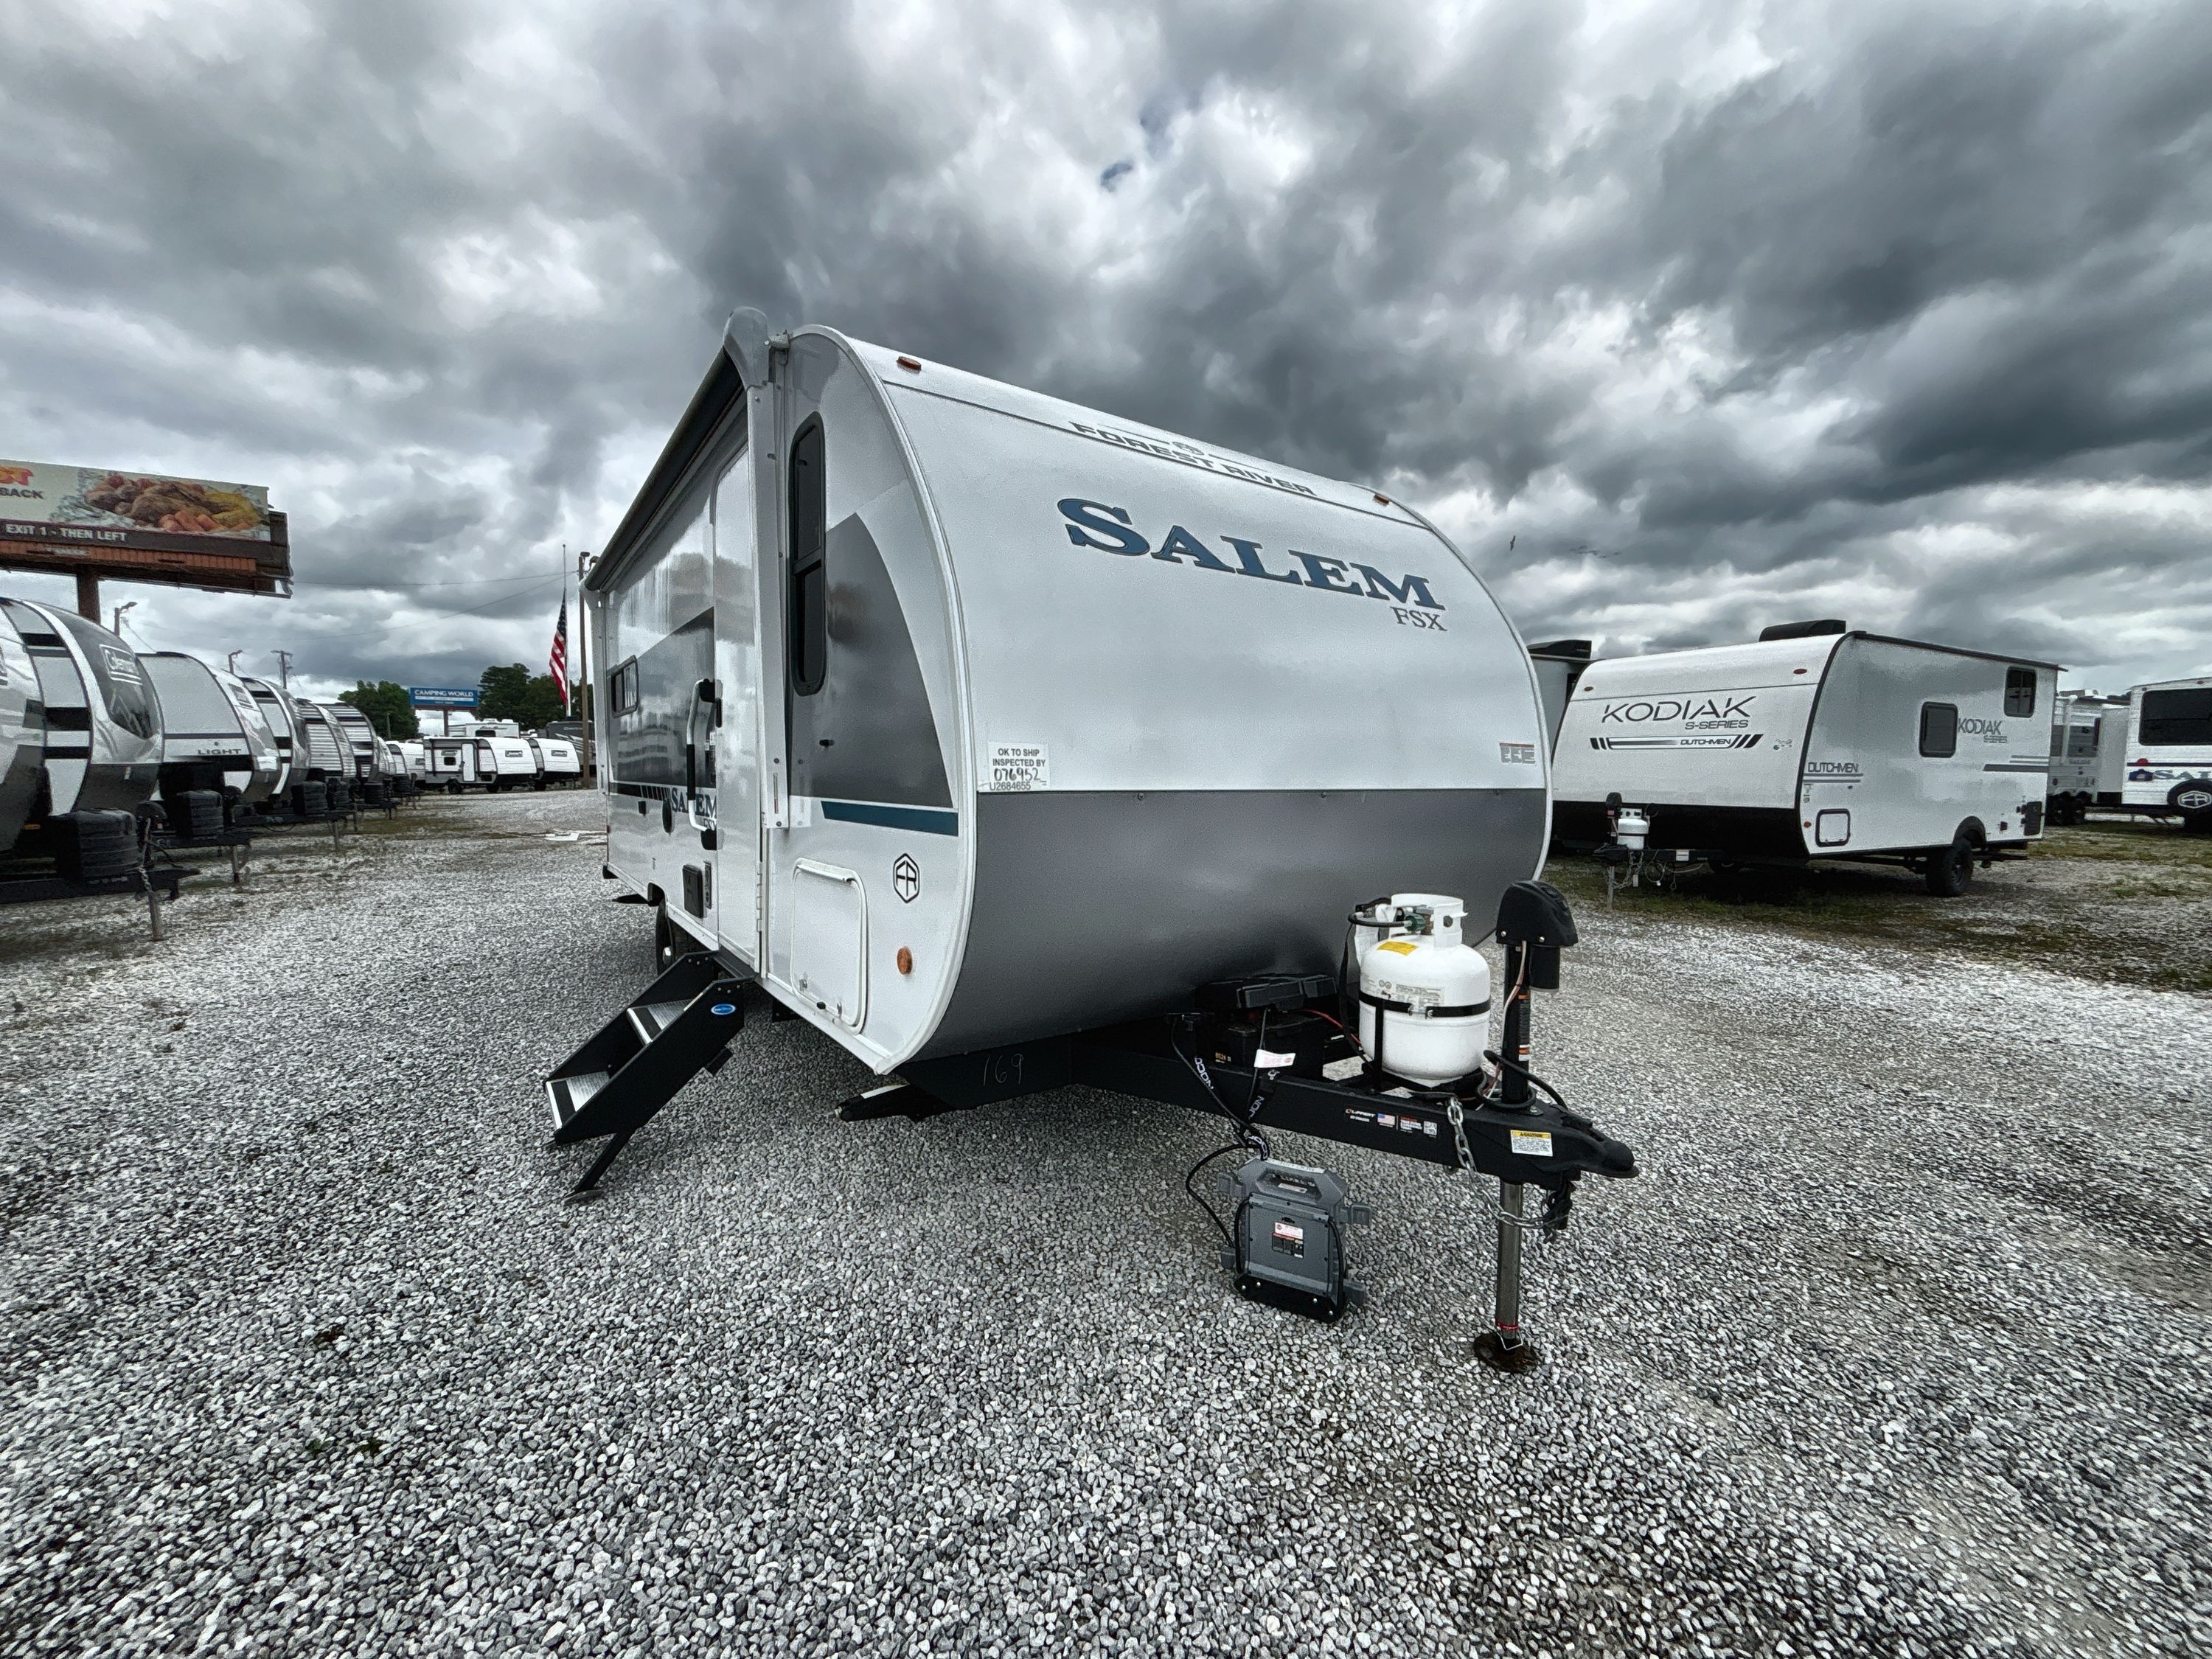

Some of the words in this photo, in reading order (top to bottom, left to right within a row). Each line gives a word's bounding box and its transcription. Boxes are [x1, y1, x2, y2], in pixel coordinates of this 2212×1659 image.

[1068, 421, 1214, 468] FOREST
[1222, 464, 1317, 496] RIVER
[6, 524, 35, 535] EXIT
[40, 527, 46, 535] 1
[60, 527, 93, 539] THEN
[97, 530, 127, 541] LEFT
[1057, 498, 1446, 611] SALEM
[1391, 606, 1447, 631] FSX
[1601, 695, 1757, 723] KODIAK
[1685, 719, 1749, 730] S-SERIES
[1958, 717, 2003, 735] KODIAK
[998, 748, 1009, 757] OK
[1011, 748, 1021, 757] TO
[992, 759, 1034, 767] INSPECTED
[1808, 762, 1859, 773] DUTCHMEN
[994, 768, 1040, 782] 076952
[990, 782, 1031, 791] U2684655
[983, 1054, 1024, 1086] 169
